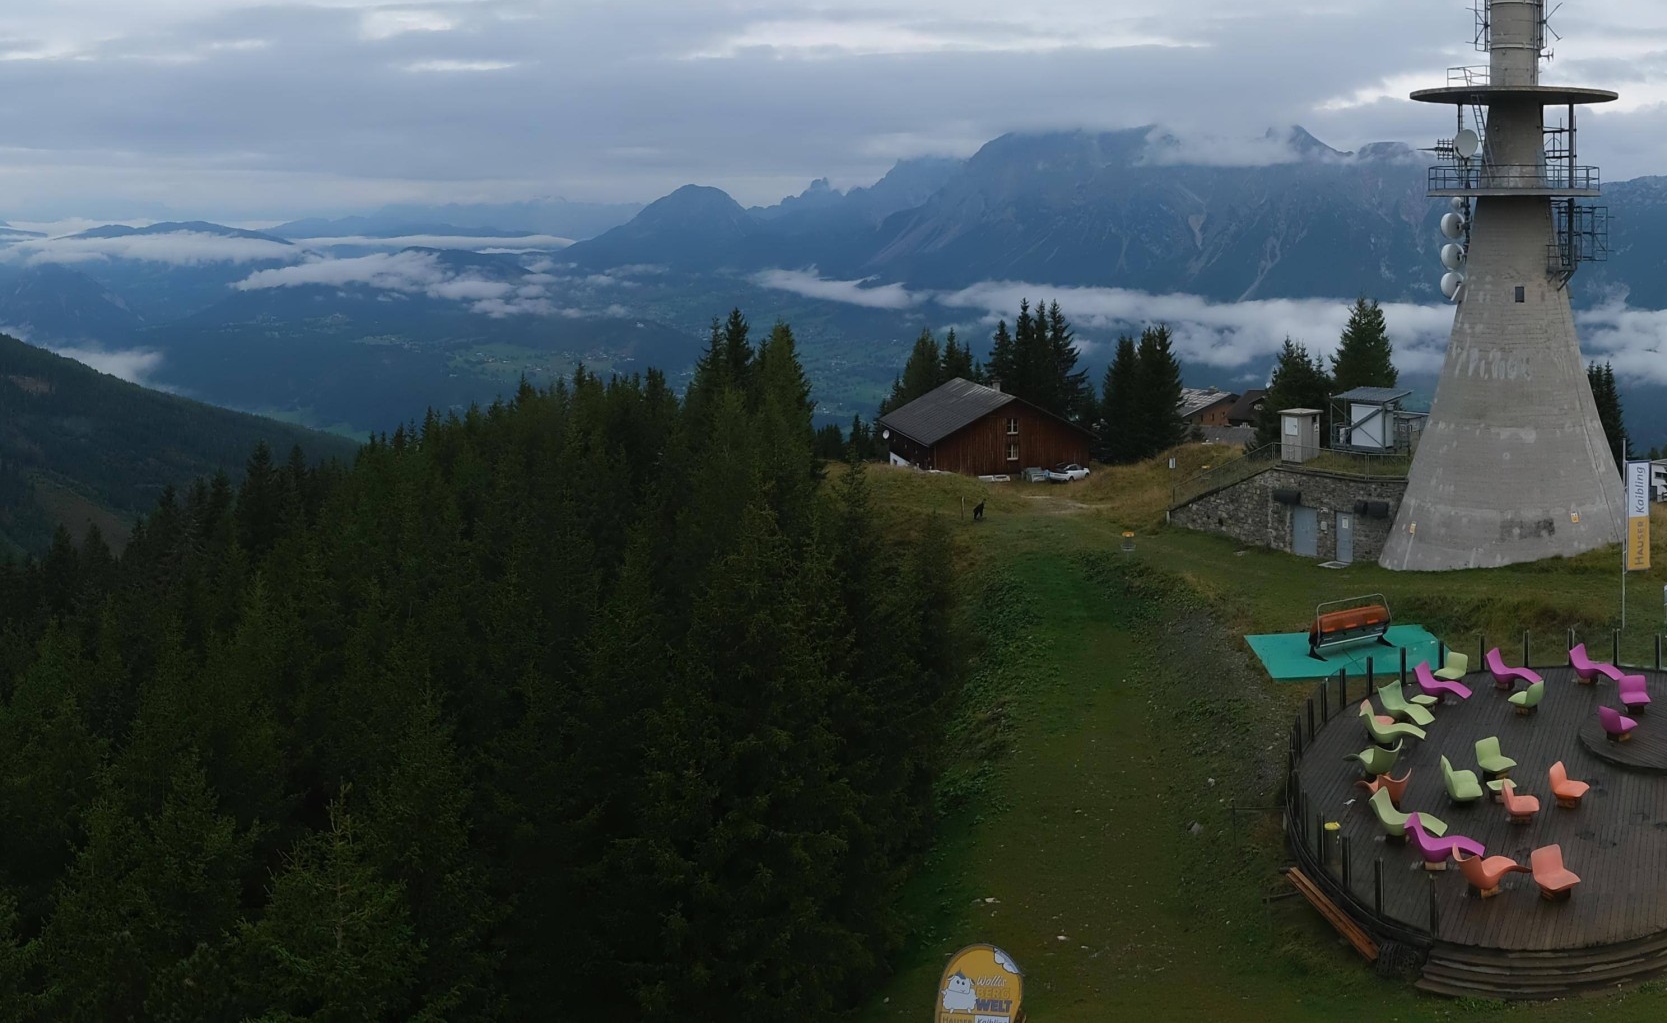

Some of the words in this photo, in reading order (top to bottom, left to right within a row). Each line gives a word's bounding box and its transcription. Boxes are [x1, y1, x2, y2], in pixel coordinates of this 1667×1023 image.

[1636, 466, 1646, 513] Kaibling
[1635, 521, 1644, 565] HAUSER
[976, 999, 1012, 1012] WELT
